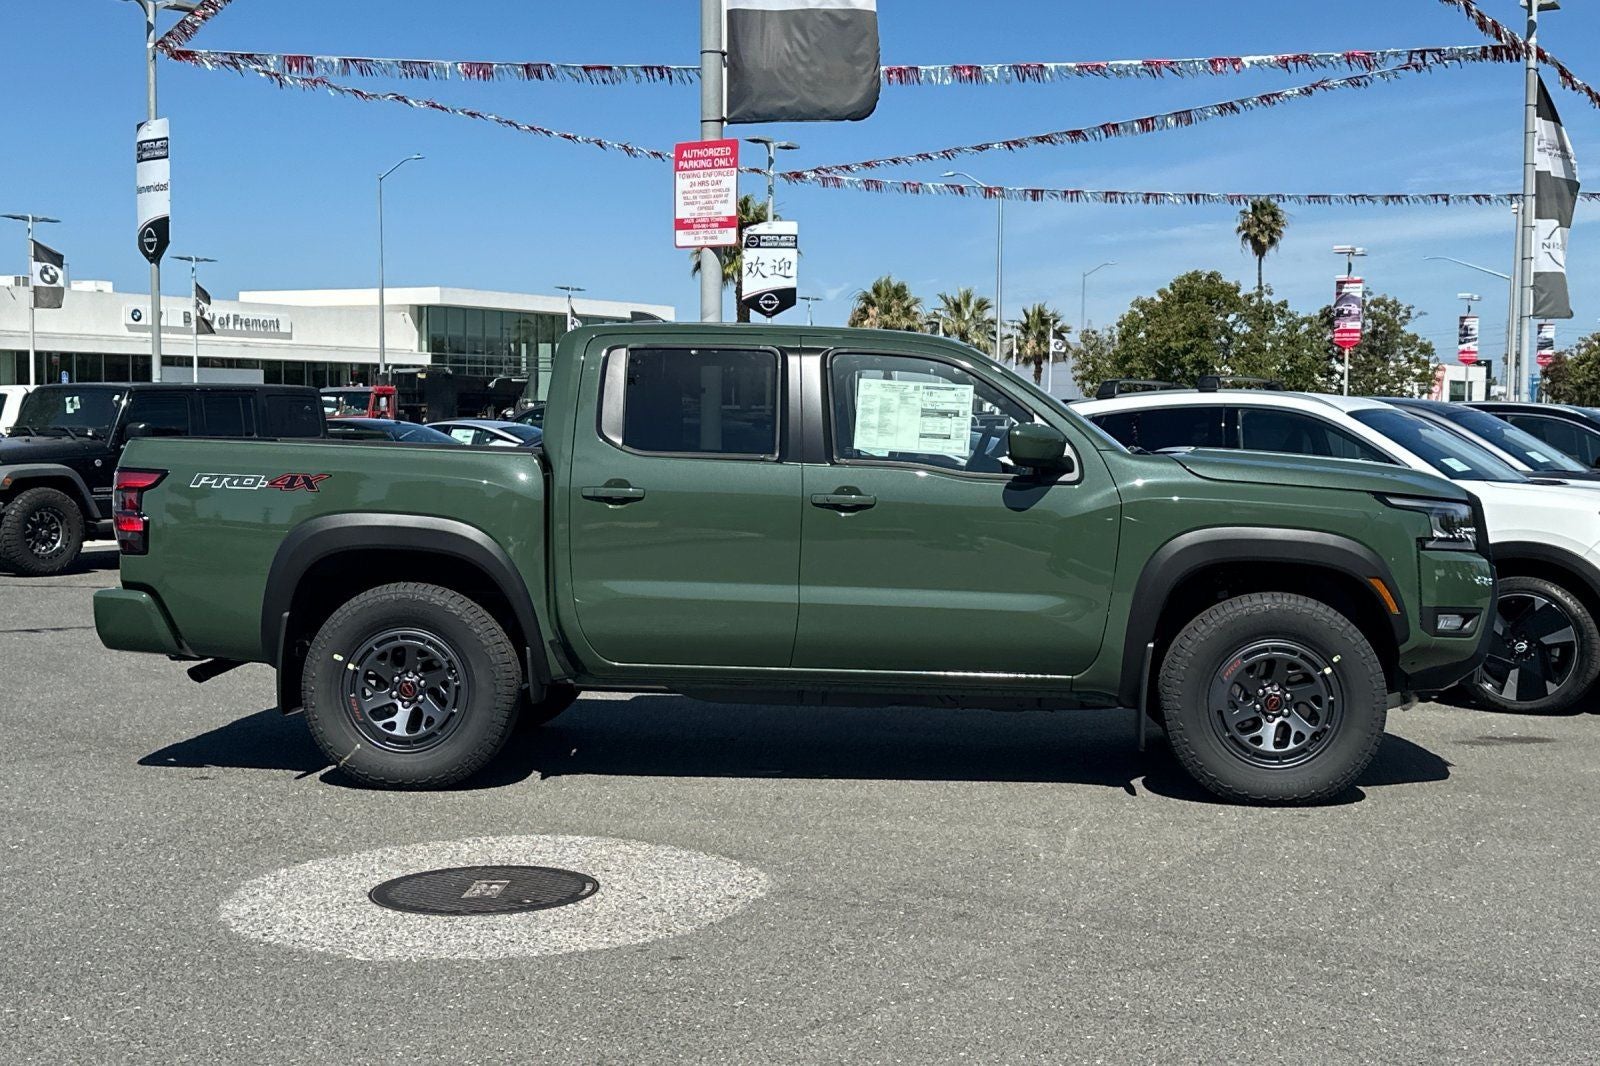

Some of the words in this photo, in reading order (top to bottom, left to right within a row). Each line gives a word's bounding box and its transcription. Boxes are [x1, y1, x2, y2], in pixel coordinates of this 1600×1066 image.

[682, 147, 731, 158] AUTHORIZED
[678, 159, 712, 169] PARKING
[713, 157, 735, 167] ONLY
[702, 170, 735, 178] ENFORCED
[746, 256, 795, 279] 欢迎
[218, 313, 231, 327] of
[232, 314, 280, 330] Fremont
